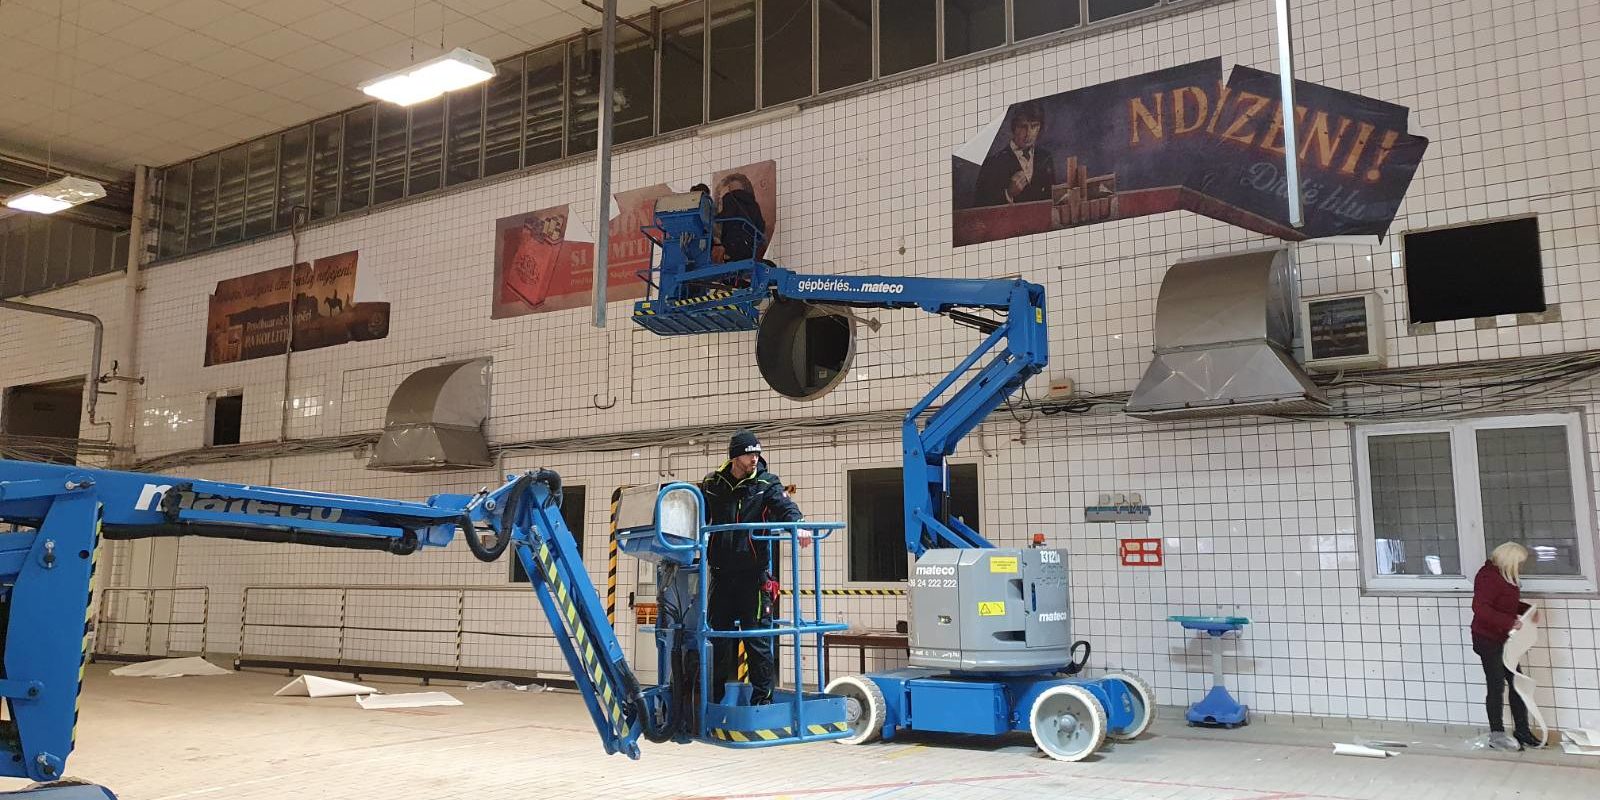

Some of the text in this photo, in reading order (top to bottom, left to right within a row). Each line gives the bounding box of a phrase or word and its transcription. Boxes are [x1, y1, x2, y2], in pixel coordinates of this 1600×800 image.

[1129, 80, 1399, 182] NDIZENI!
[916, 564, 956, 576] mateco
[1038, 611, 1067, 623] mateco
